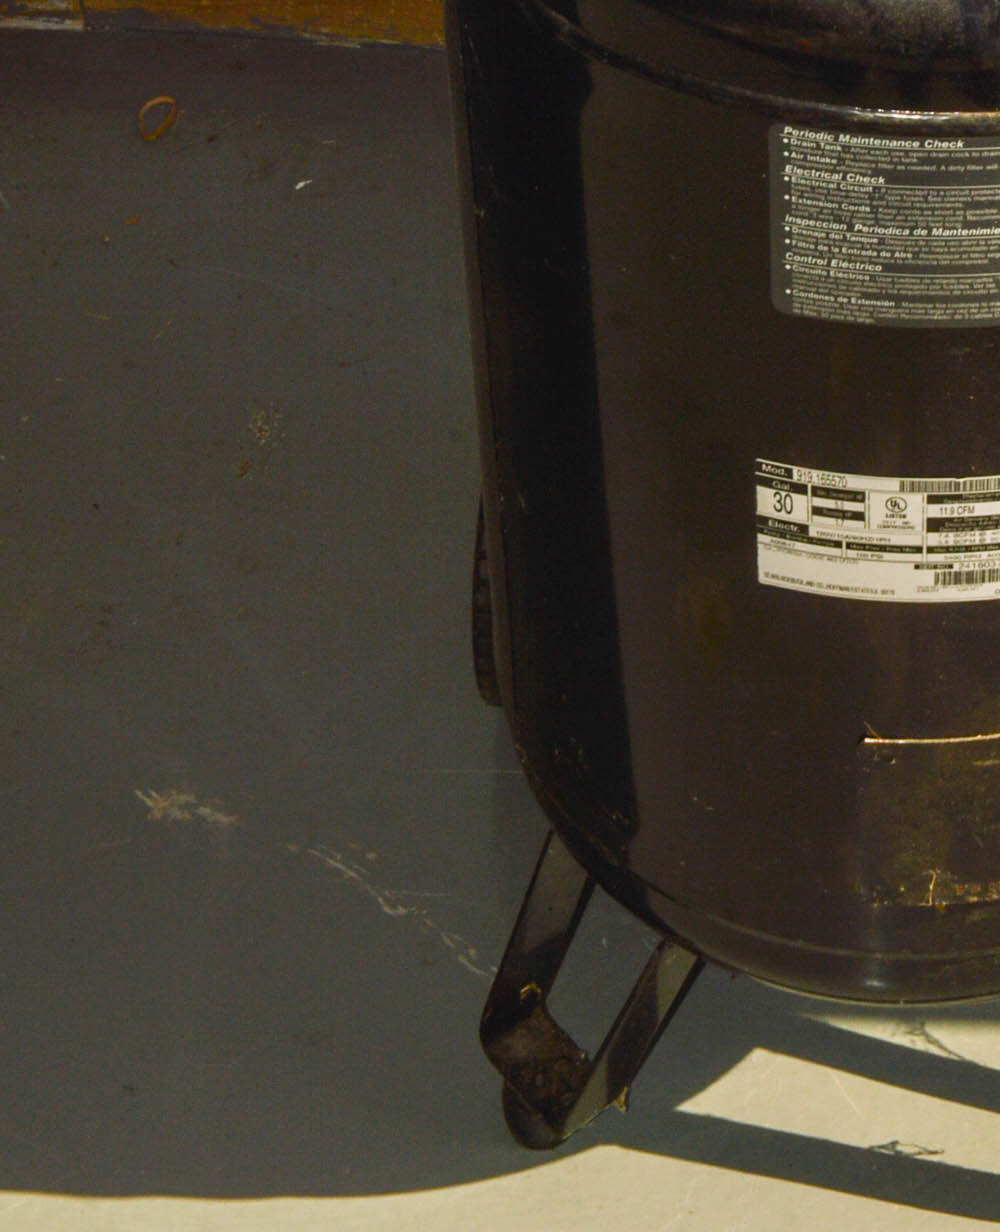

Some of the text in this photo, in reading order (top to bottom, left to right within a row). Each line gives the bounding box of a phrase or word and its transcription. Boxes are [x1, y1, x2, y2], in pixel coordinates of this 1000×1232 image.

[784, 126, 966, 148] Periodic Maintenance Check
[790, 138, 816, 148] Drain
[820, 142, 843, 151] Tank
[790, 151, 804, 160] Air
[806, 154, 838, 164] Intake
[784, 164, 843, 178] Electrical
[846, 173, 886, 184] Check
[791, 176, 837, 188] Electrical
[840, 183, 873, 192] Circuit
[791, 195, 838, 208] Extension
[841, 202, 871, 212] Cords
[792, 227, 827, 238] Drenaje
[828, 232, 843, 240] del
[846, 234, 879, 244] Tanque
[854, 224, 910, 236] Periodica
[913, 228, 928, 236] de
[792, 240, 815, 250] Filtro
[817, 242, 829, 251] de
[842, 246, 878, 257] Entrada
[880, 250, 891, 258] de
[785, 252, 828, 266] Control
[792, 264, 828, 276] Circuito
[761, 463, 788, 477] Mod.
[773, 492, 794, 514] 30
[956, 506, 976, 515] CFM
[768, 518, 800, 533] Electr.
